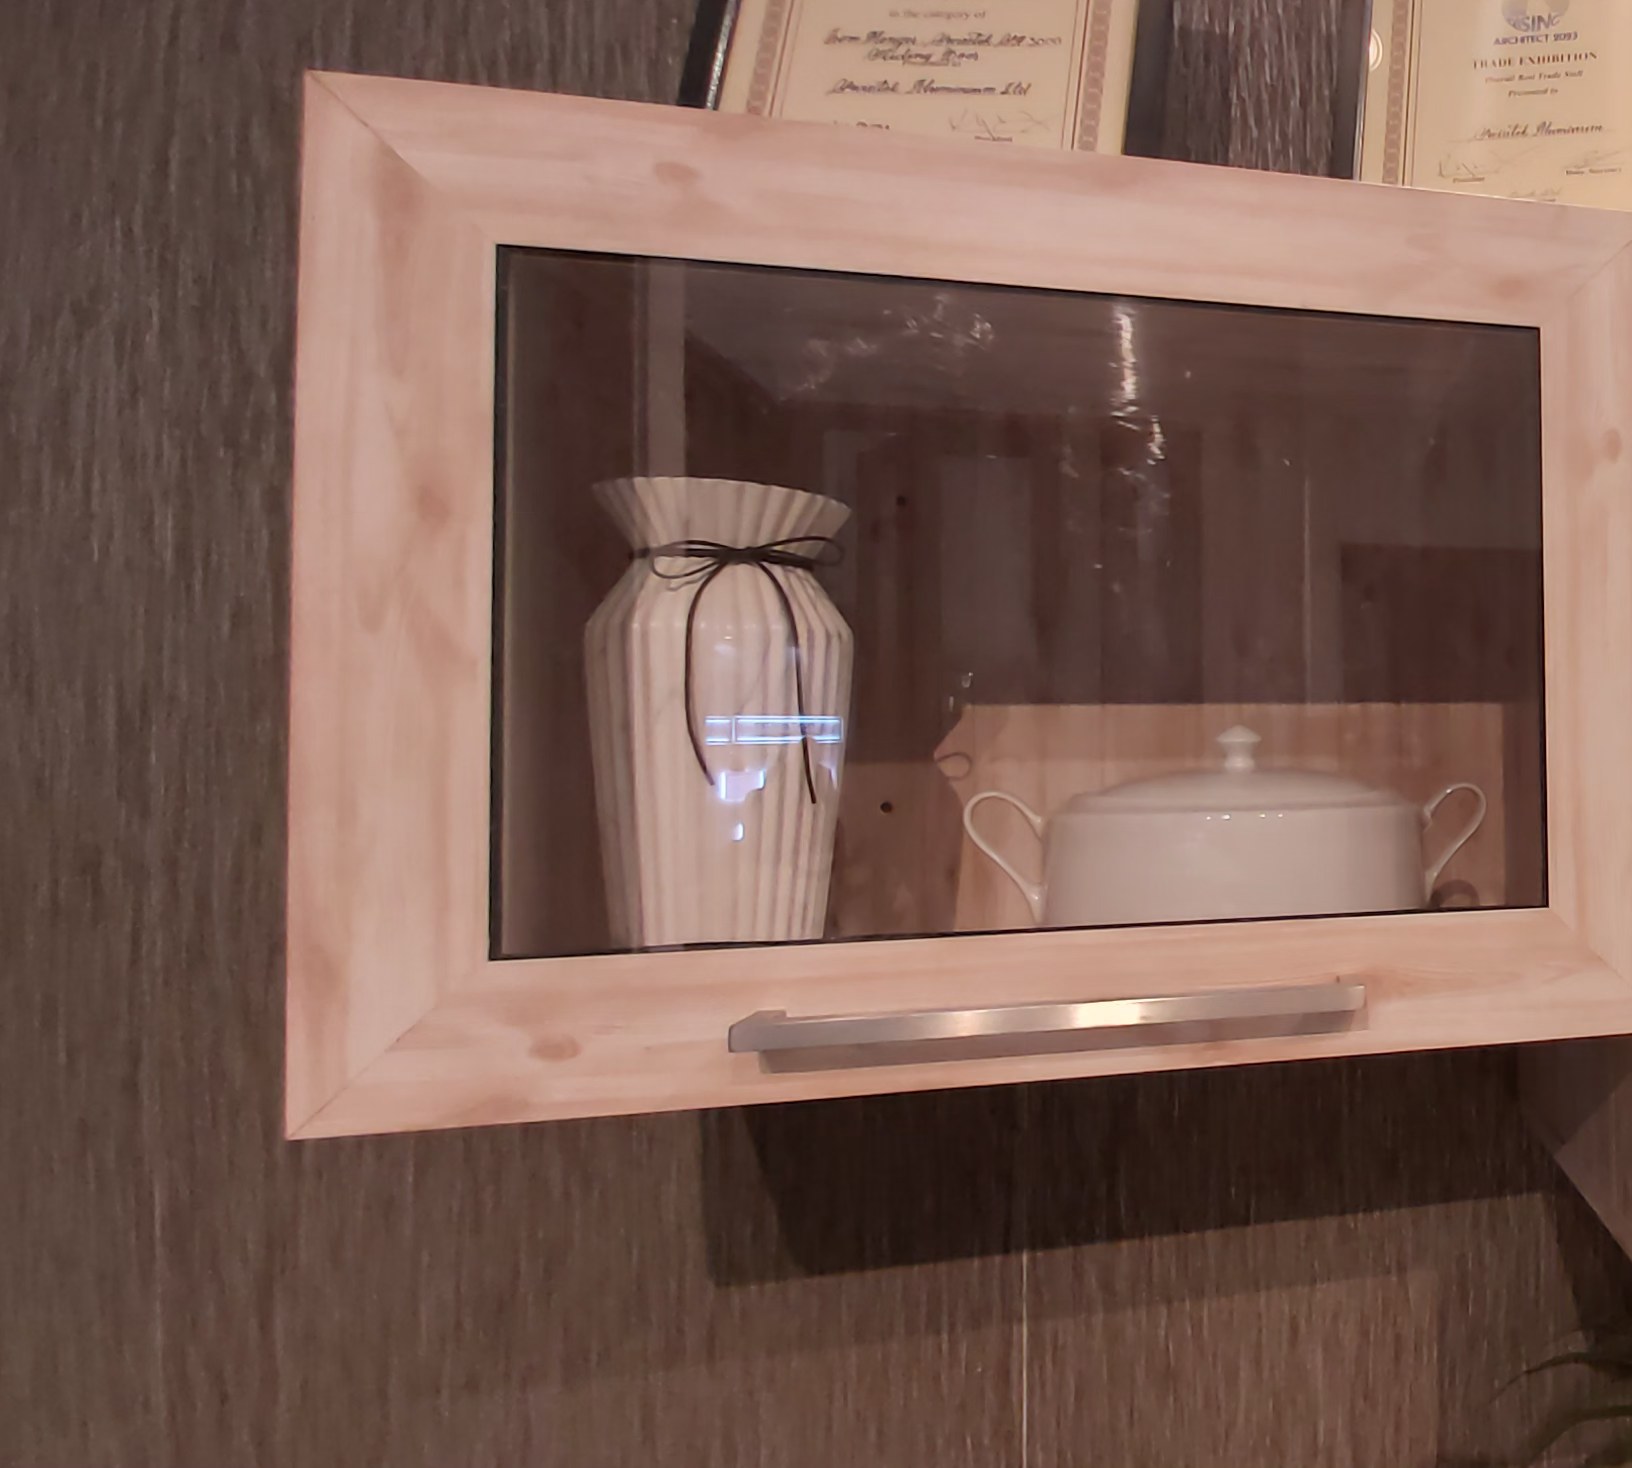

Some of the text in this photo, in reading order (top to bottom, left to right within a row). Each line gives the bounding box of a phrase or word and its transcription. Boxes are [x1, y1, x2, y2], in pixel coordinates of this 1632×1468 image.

[1493, 34, 1549, 46] ARCHITECT
[1473, 51, 1598, 70] TRADE EXHIBITION
